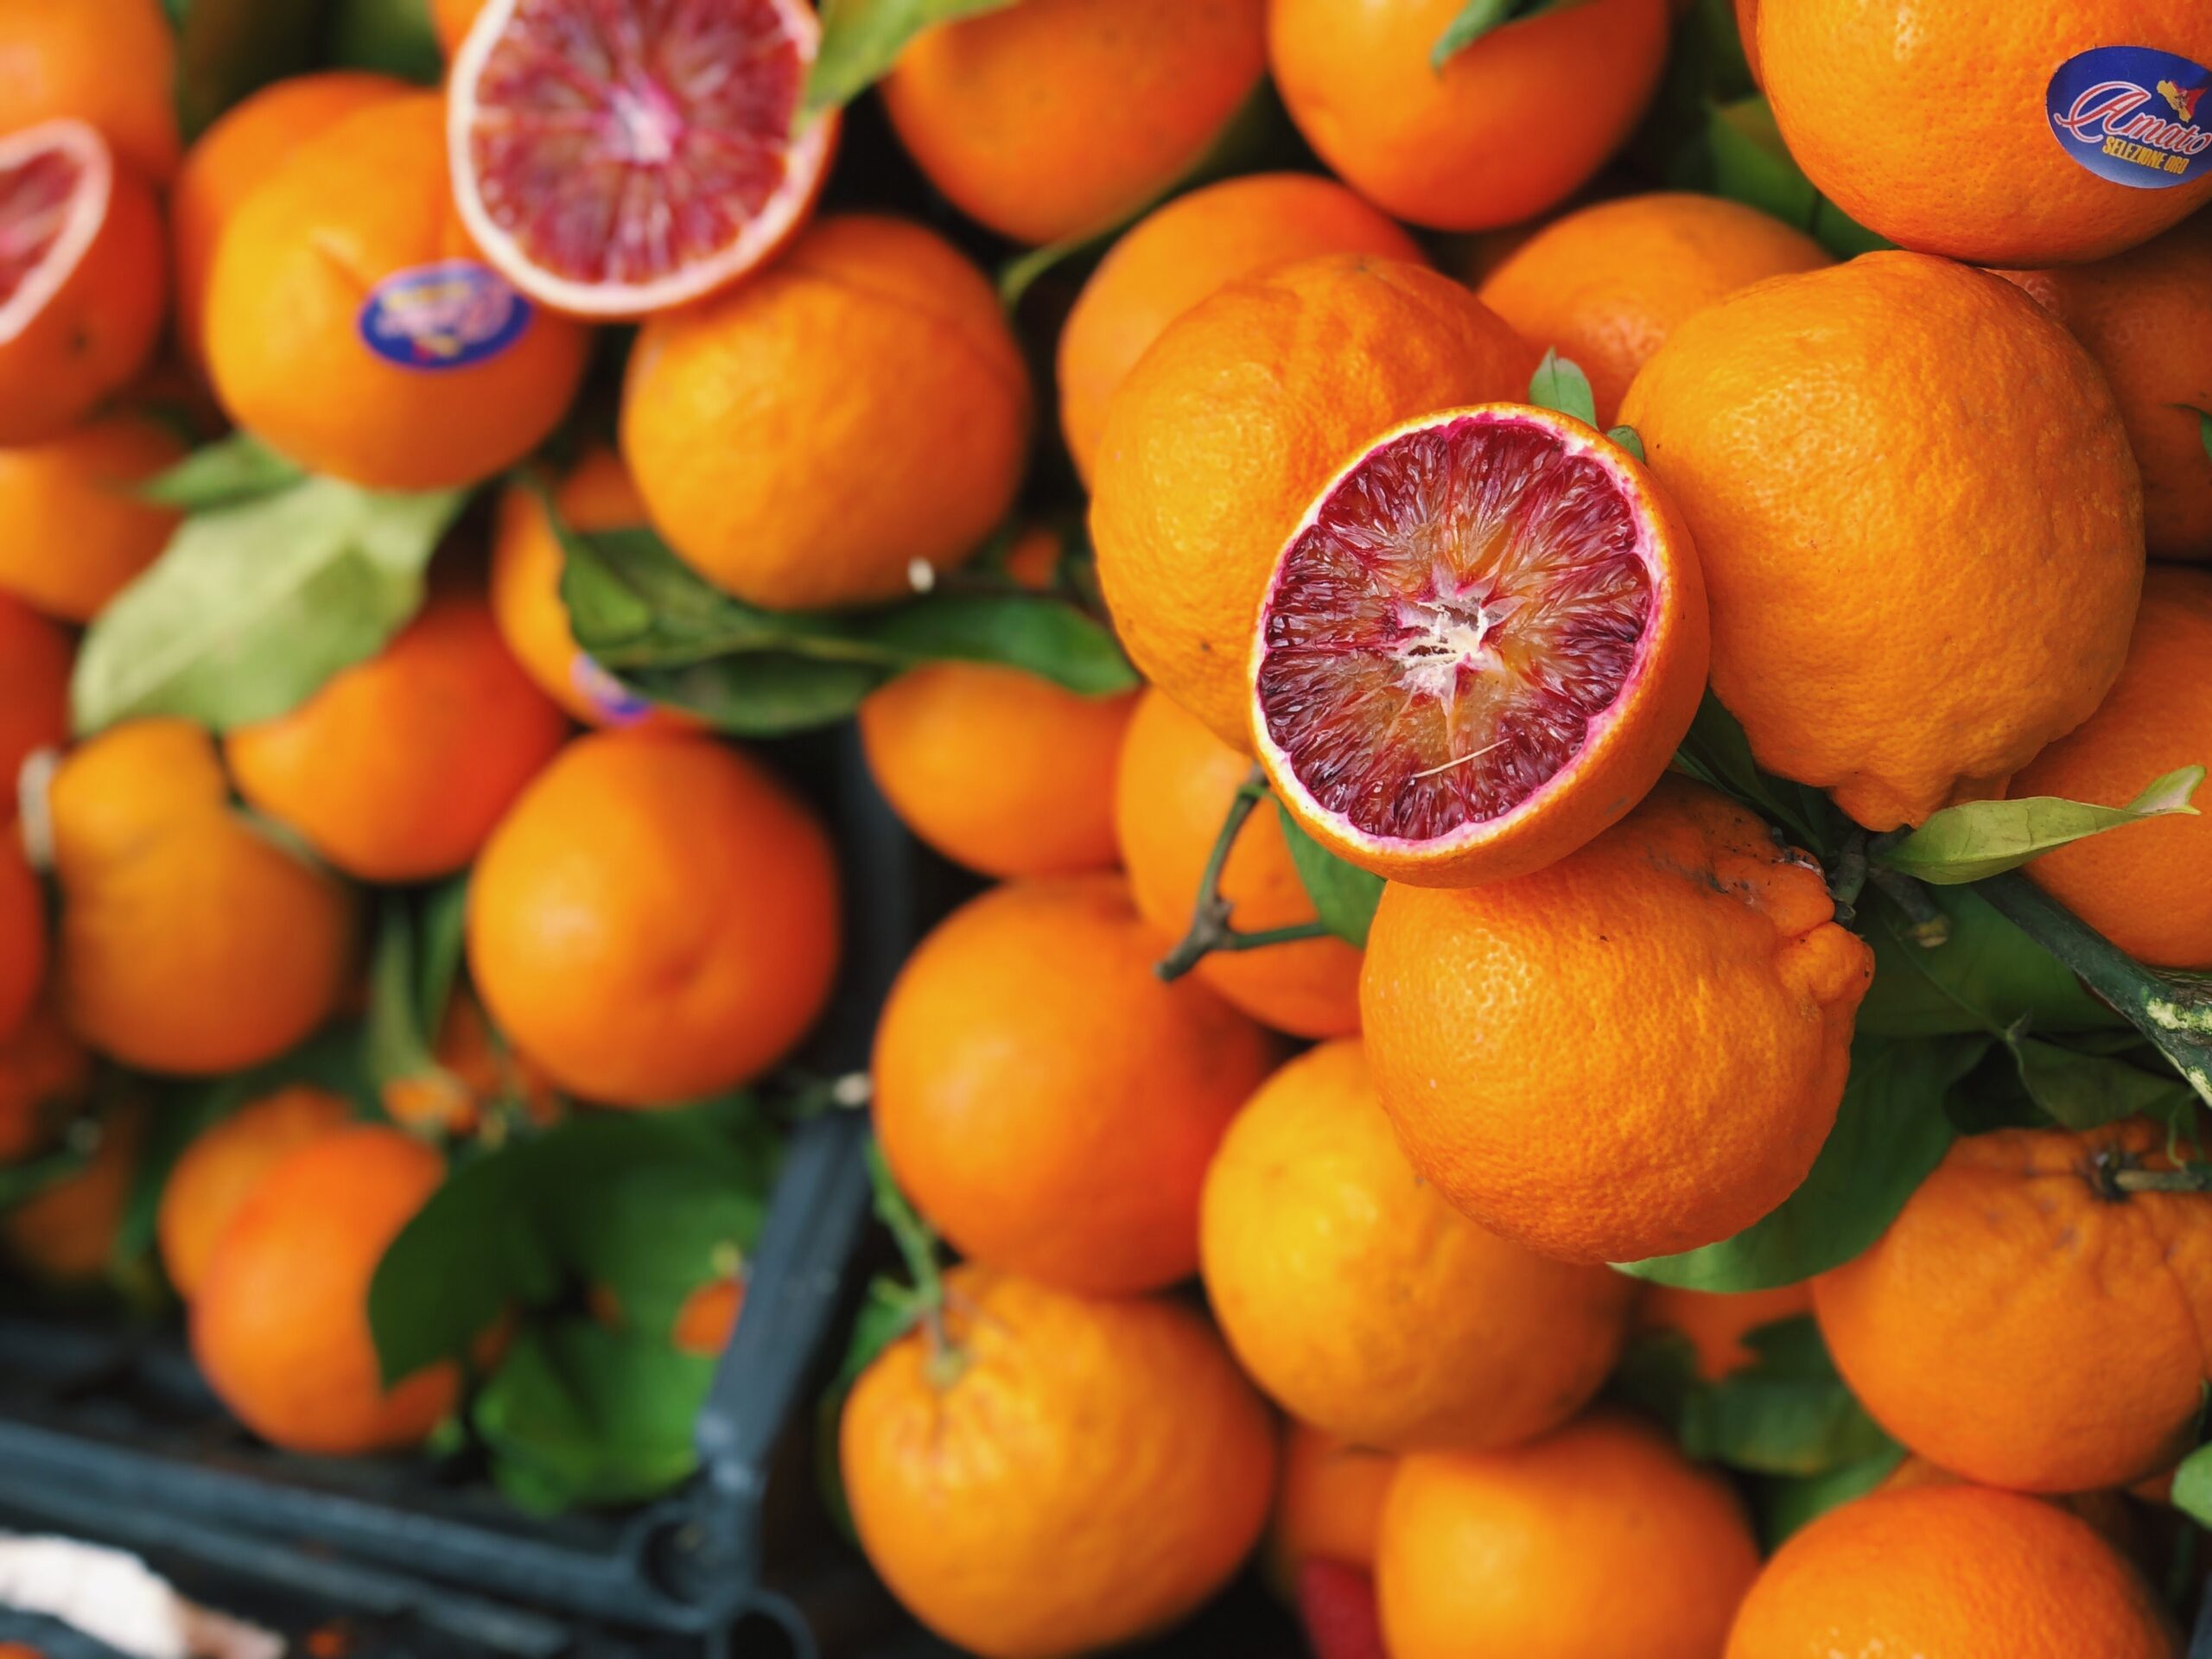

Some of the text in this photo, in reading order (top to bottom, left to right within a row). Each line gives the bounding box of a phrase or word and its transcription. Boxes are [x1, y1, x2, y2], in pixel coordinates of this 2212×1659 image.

[2054, 81, 2212, 155] Amato
[2101, 136, 2190, 175] SELEZIONE ORO
